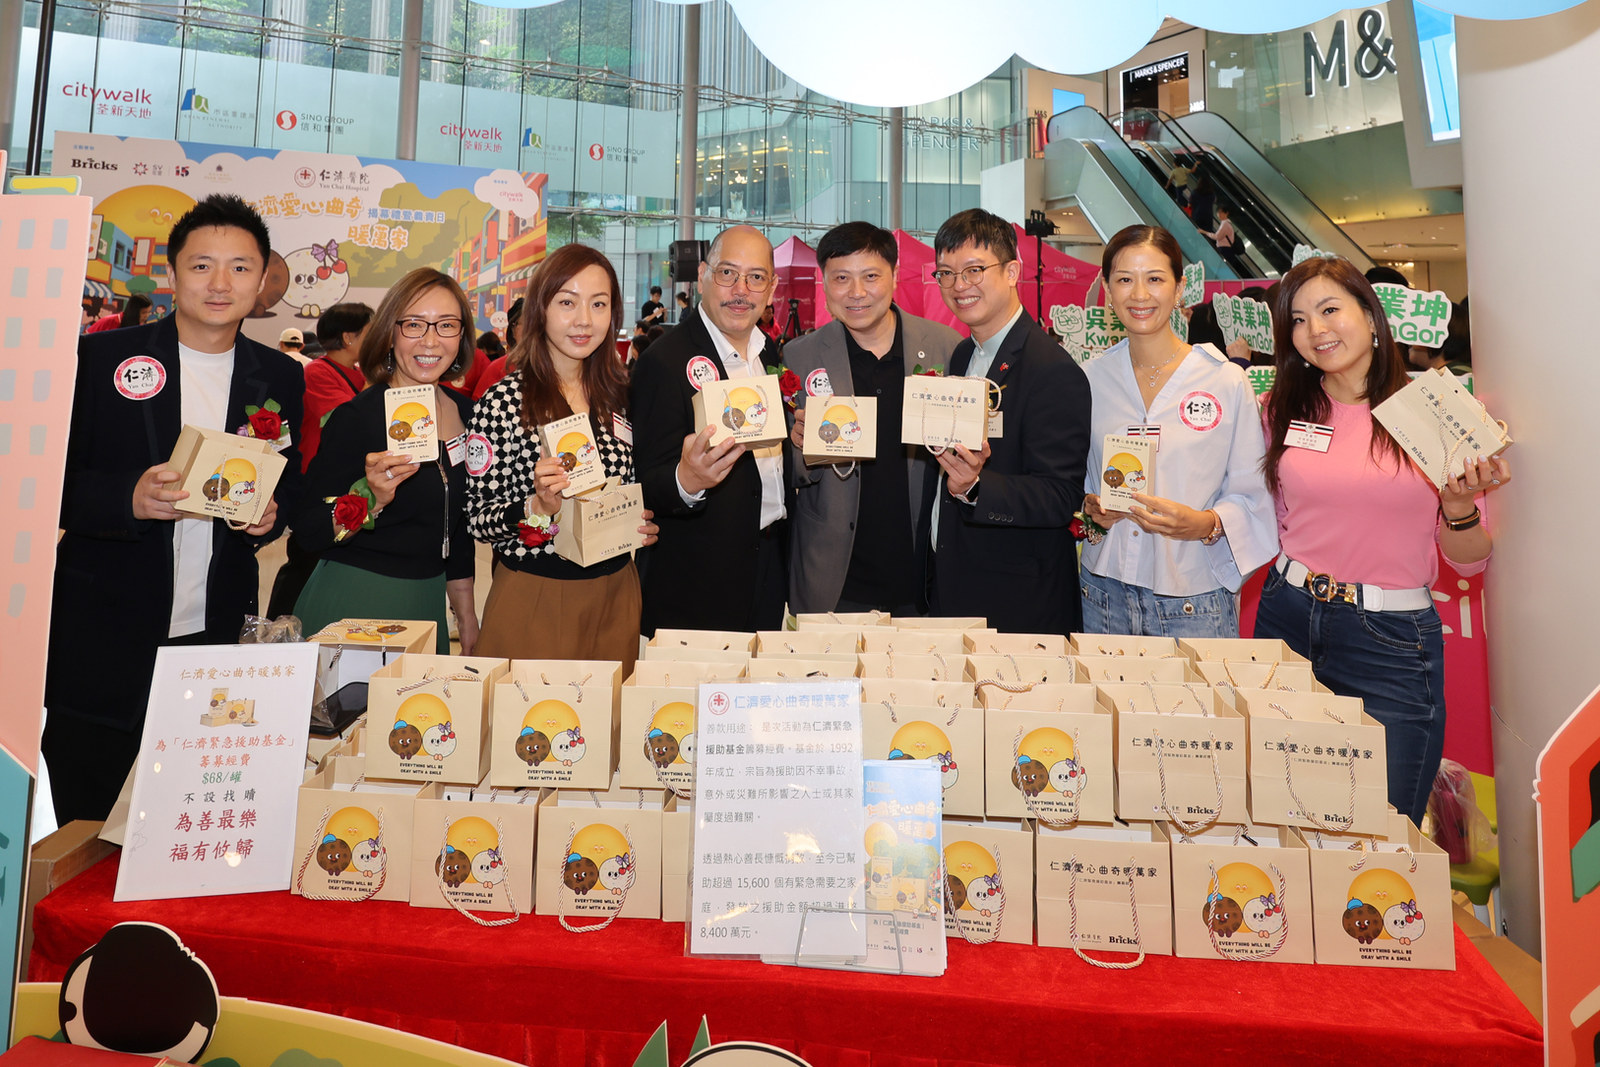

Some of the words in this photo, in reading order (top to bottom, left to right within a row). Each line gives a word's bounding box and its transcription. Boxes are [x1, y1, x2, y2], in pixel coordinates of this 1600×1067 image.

[1134, 68, 1153, 79] MARKS
[1157, 57, 1185, 72] SPENCER
[62, 81, 152, 105] citywalk
[96, 103, 152, 119] 荃新天地
[300, 113, 322, 122] SINO
[324, 115, 355, 126] GROUP
[300, 122, 344, 136] 信和集團
[440, 122, 502, 141] citywalk
[464, 140, 503, 153] 荃新天地
[606, 145, 622, 154] SINO
[71, 158, 118, 171] Bricks
[319, 169, 370, 185] 仁濟醫院
[348, 223, 408, 249] 暖萬家
[1374, 286, 1448, 327] 業坤
[1231, 299, 1271, 334] 吳業坤
[123, 366, 156, 383] 仁濟
[1186, 401, 1215, 418] 仁濟
[180, 665, 296, 680] 仁濟愛心曲奇暖萬家
[733, 694, 850, 709] 仁濟愛心曲奇暖萬家
[761, 720, 853, 733] 是次活動為仁濟緊急
[155, 734, 296, 752] 為「仁濟緊急援助基金」
[830, 742, 853, 753] 1992
[1263, 740, 1373, 760] 仁濟愛心曲奇暖萬家
[202, 771, 242, 785] $68/罐
[183, 788, 257, 805] 不設找贖
[704, 787, 854, 800] 意外或災難所影響之人士或其家
[1187, 805, 1214, 815] Bricks
[174, 809, 257, 832] 為善最樂
[169, 837, 254, 863] 福有攸歸
[702, 876, 733, 889] 助超過
[737, 877, 770, 889] 15,600
[774, 876, 857, 889] 個有緊急需要之家
[700, 927, 728, 939] 8,400
[1109, 935, 1138, 945] Bricks
